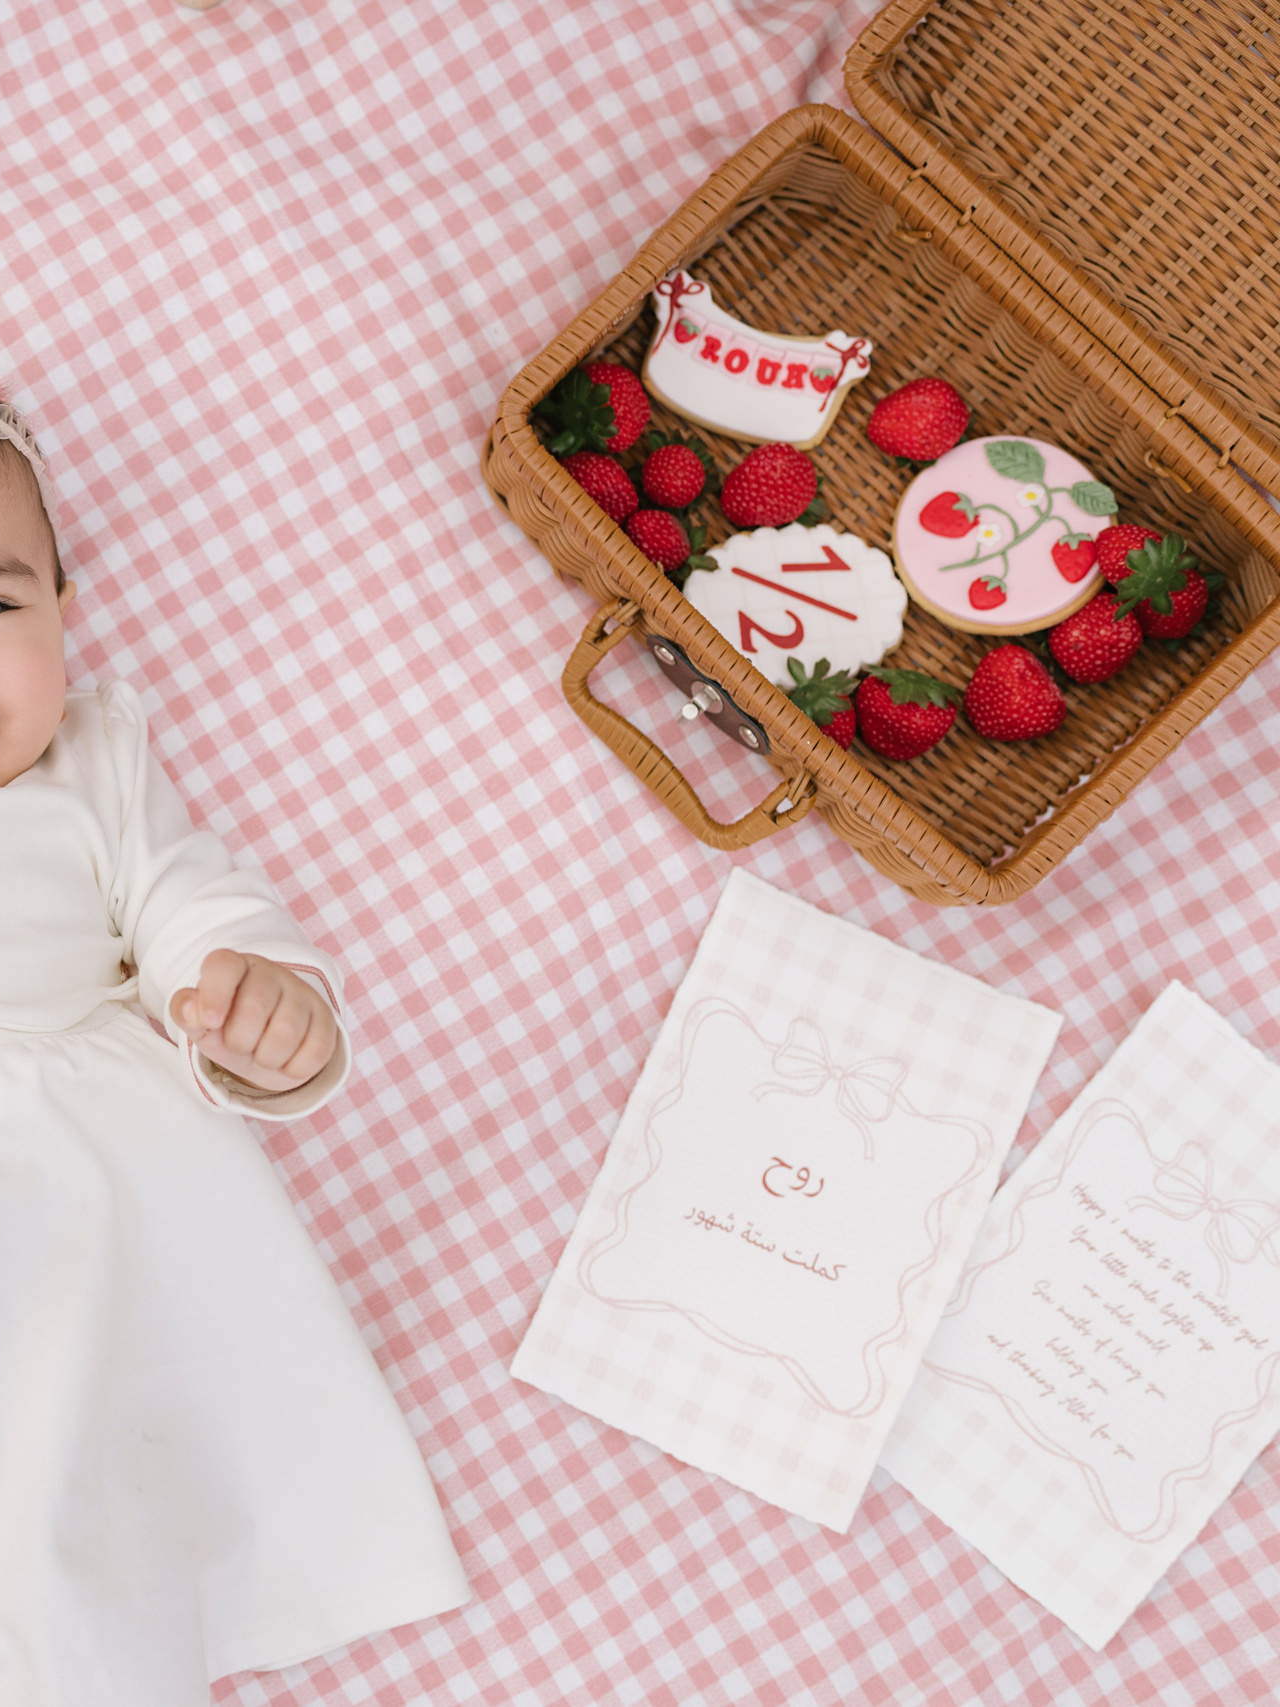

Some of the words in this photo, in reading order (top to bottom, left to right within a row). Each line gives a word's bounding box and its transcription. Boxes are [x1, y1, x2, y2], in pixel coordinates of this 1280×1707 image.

[700, 335, 807, 389] ROUH
[731, 545, 858, 653] 1/2
[761, 1155, 825, 1199] روح
[683, 1206, 735, 1234] شهور
[739, 1221, 777, 1253] ستة
[781, 1249, 848, 1282] كملت
[1068, 1225, 1098, 1253] Your
[1099, 1251, 1129, 1278] little
[1127, 1279, 1159, 1304] smile
[1159, 1302, 1196, 1335] lights
[1198, 1337, 1215, 1352] up
[1070, 1183, 1107, 1220] Happy
[1157, 1257, 1172, 1271] to
[1171, 1270, 1192, 1289] the
[1191, 1290, 1242, 1327] sweetest
[1233, 1328, 1270, 1350] girl
[1093, 1338, 1113, 1354] of
[1102, 1302, 1134, 1327] whole
[1135, 1330, 1171, 1354] world
[1045, 1337, 1085, 1379] holding
[987, 1334, 1012, 1350] and
[1007, 1350, 1056, 1398] thanking
[1057, 1397, 1096, 1424] Allah
[1089, 1423, 1111, 1441] for
